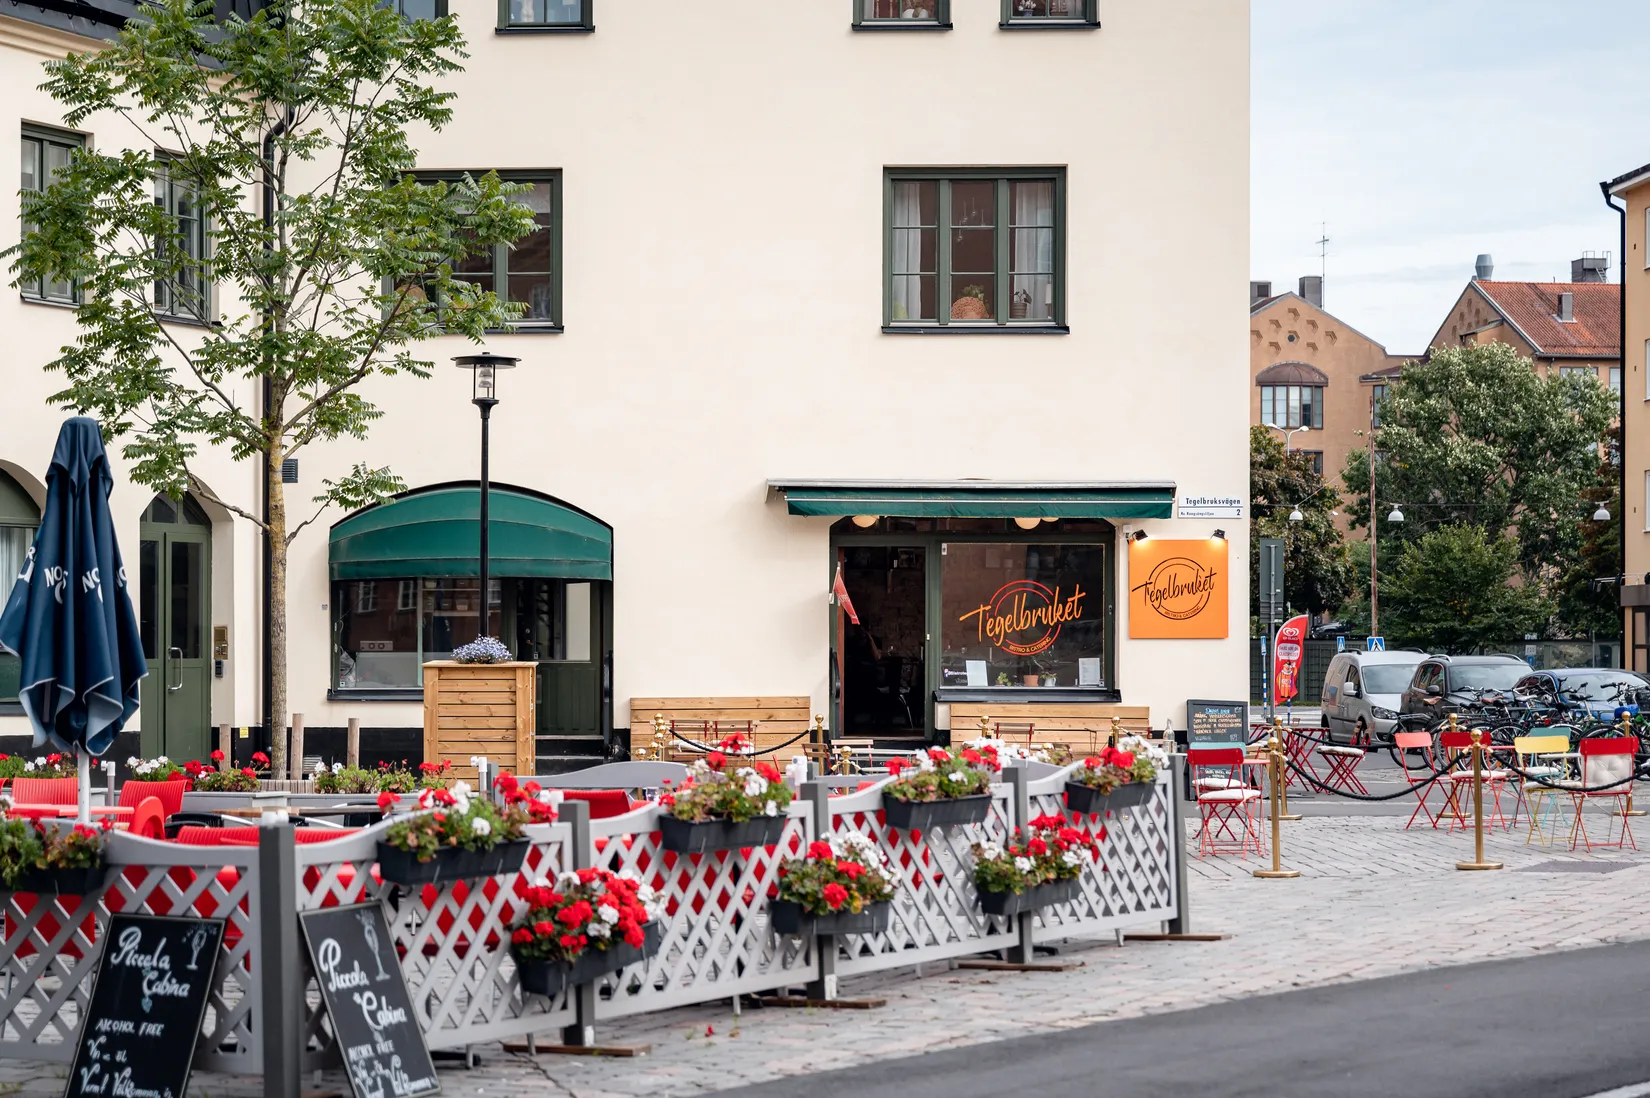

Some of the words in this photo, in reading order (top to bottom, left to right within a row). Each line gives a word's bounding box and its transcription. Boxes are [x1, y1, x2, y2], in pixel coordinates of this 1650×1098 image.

[1186, 497, 1240, 506] Tegelbruksvägen
[1132, 567, 1217, 609] Tegelbruket
[959, 584, 1086, 646] Tegelbruket
[1030, 637, 1051, 651] CATERING
[318, 938, 370, 992] Piccola
[142, 971, 190, 996] Cabina
[361, 991, 407, 1030] Cabina
[96, 1018, 135, 1034] ALCOHOL
[138, 1022, 164, 1037] FREE
[376, 1040, 395, 1055] FREE
